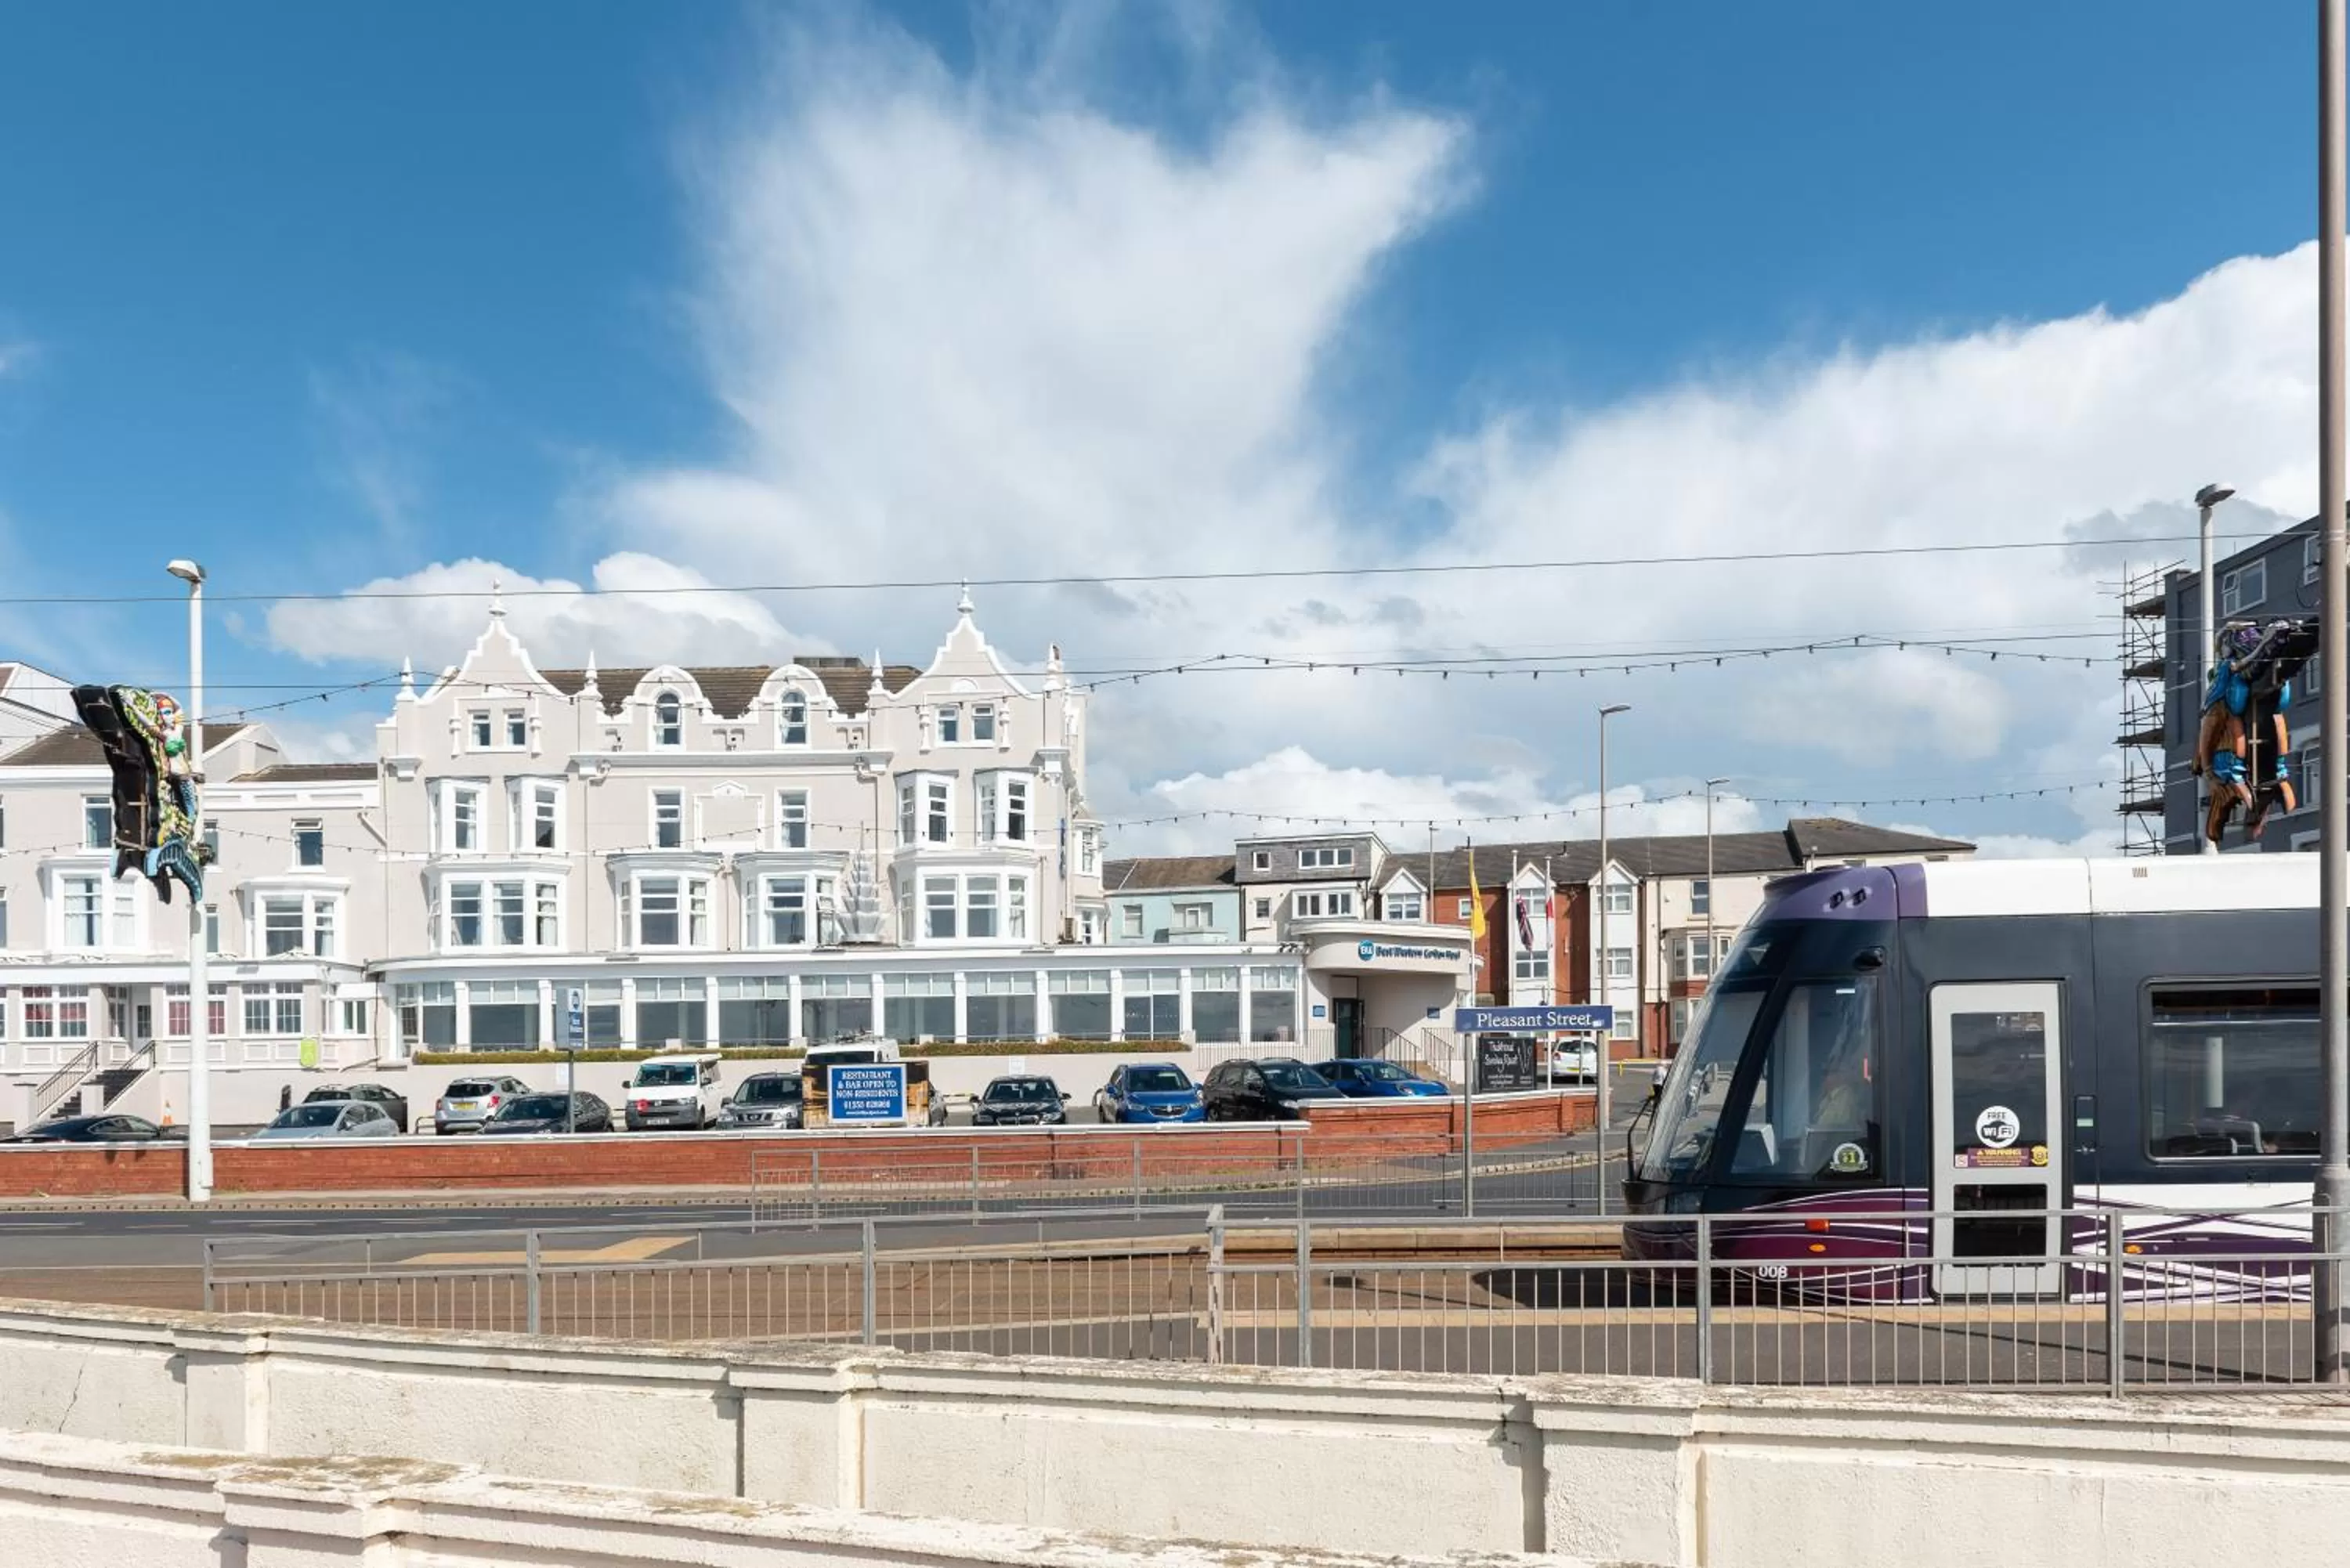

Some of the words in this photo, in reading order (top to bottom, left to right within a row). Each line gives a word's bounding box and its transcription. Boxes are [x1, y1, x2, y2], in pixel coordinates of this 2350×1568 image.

[1477, 1013, 1542, 1028] Pleasant
[1546, 1011, 1592, 1025] Street
[842, 1071, 891, 1079] RESTAURANT
[1759, 1265, 1788, 1278] 008
